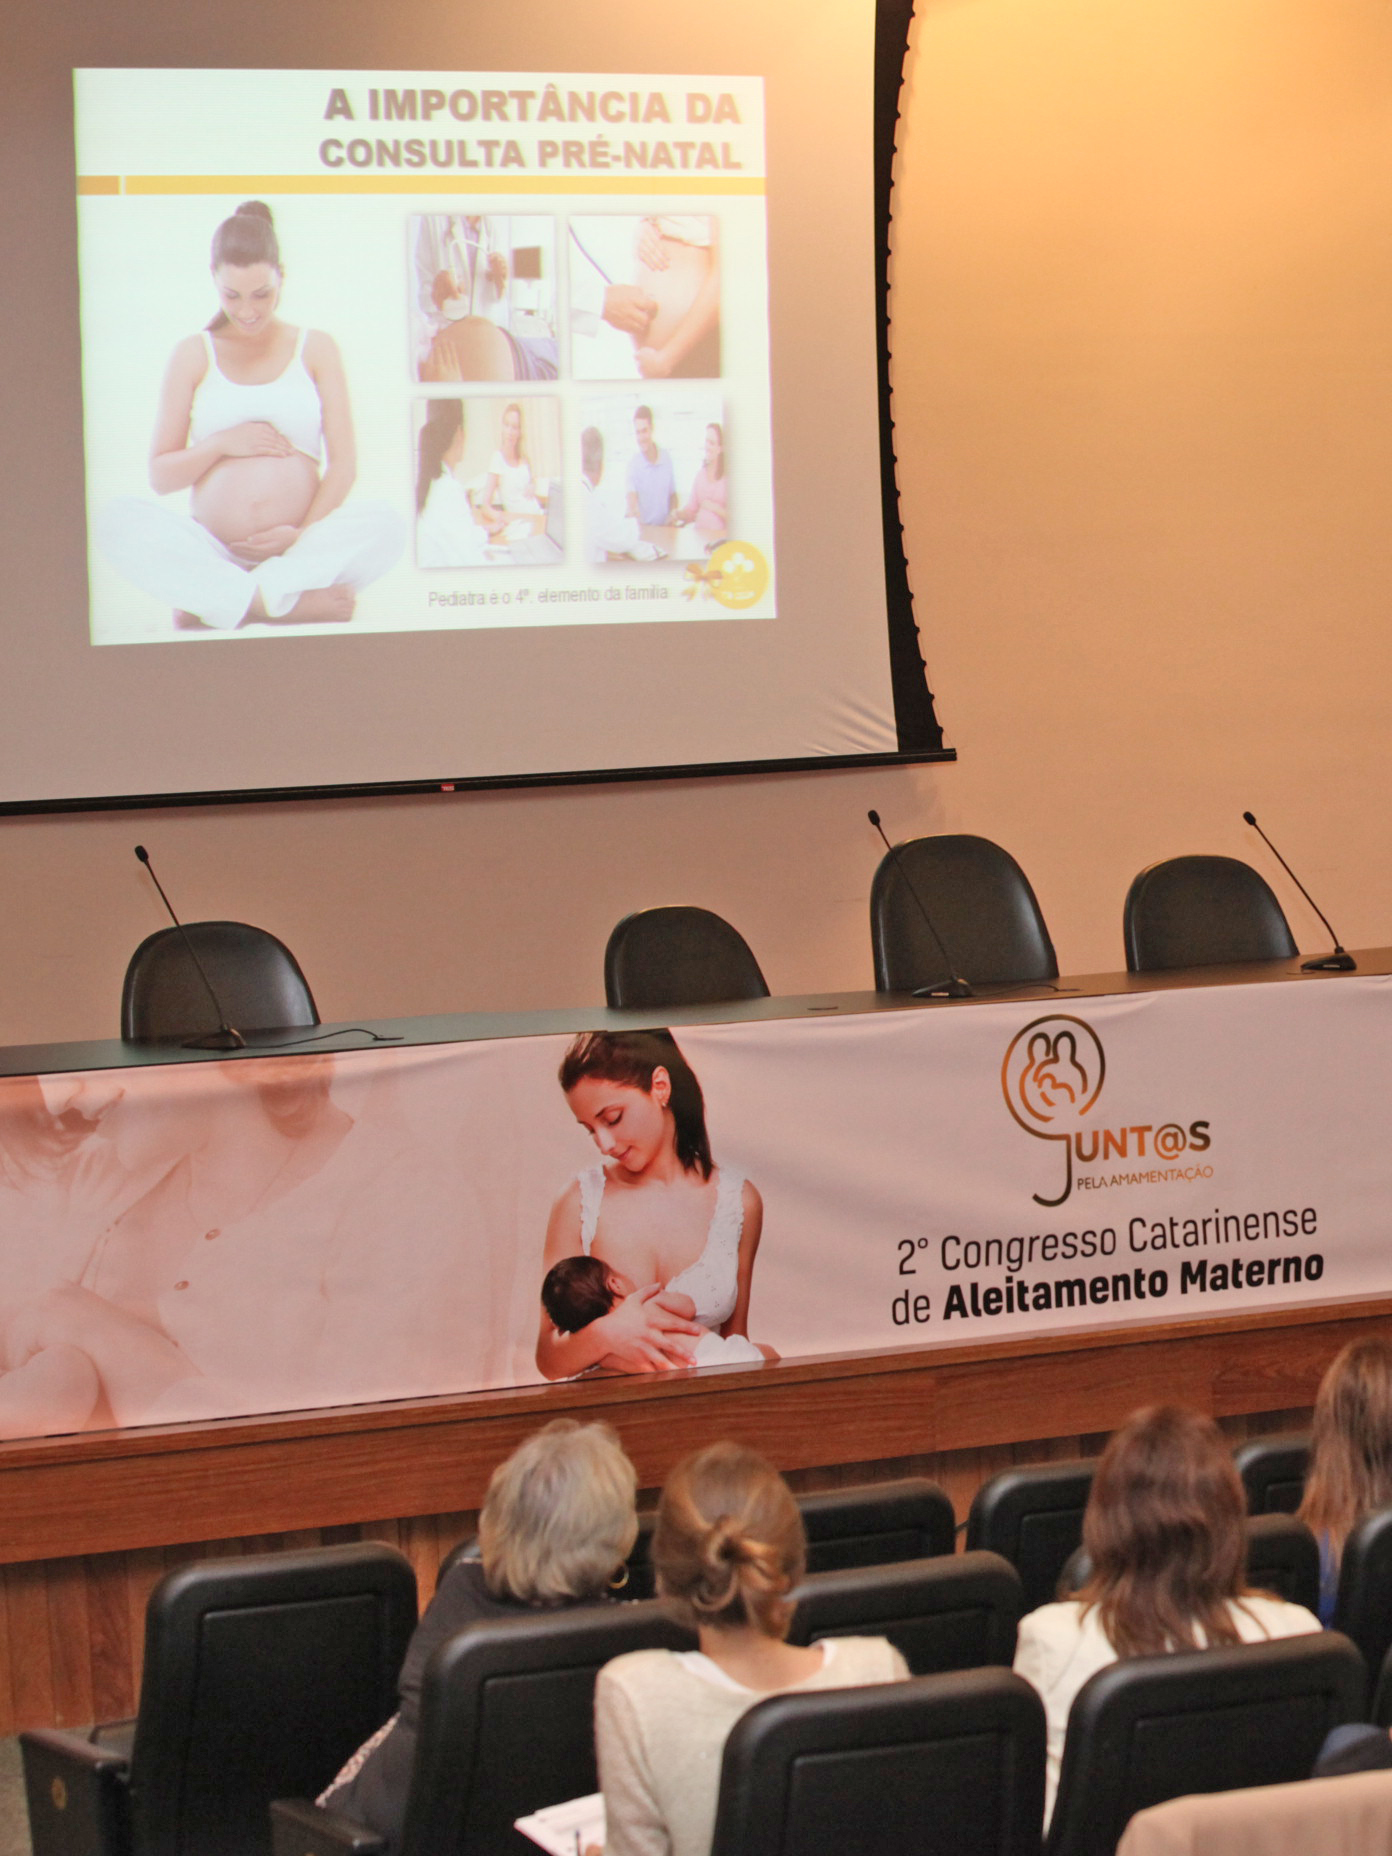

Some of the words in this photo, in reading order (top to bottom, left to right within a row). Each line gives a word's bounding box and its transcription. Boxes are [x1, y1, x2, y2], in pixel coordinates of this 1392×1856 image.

[323, 88, 354, 121] A
[368, 82, 671, 124] IMPORTÂNCIA
[685, 92, 742, 124] DA
[318, 138, 525, 168] CONSULTA
[537, 134, 742, 170] PRÉ-NATAL
[428, 592, 486, 608] Pediatra
[502, 591, 511, 605] o
[537, 587, 600, 603] elemento
[604, 586, 621, 602] da
[1077, 1176, 1109, 1190] PELA
[1110, 1163, 1214, 1187] AMAMENTAÇÃO
[941, 1222, 1117, 1273] Congresso
[1128, 1207, 1318, 1253] Catarinense
[891, 1289, 931, 1326] de
[943, 1268, 1169, 1320] Aleitamento
[1180, 1253, 1325, 1294] Materno
